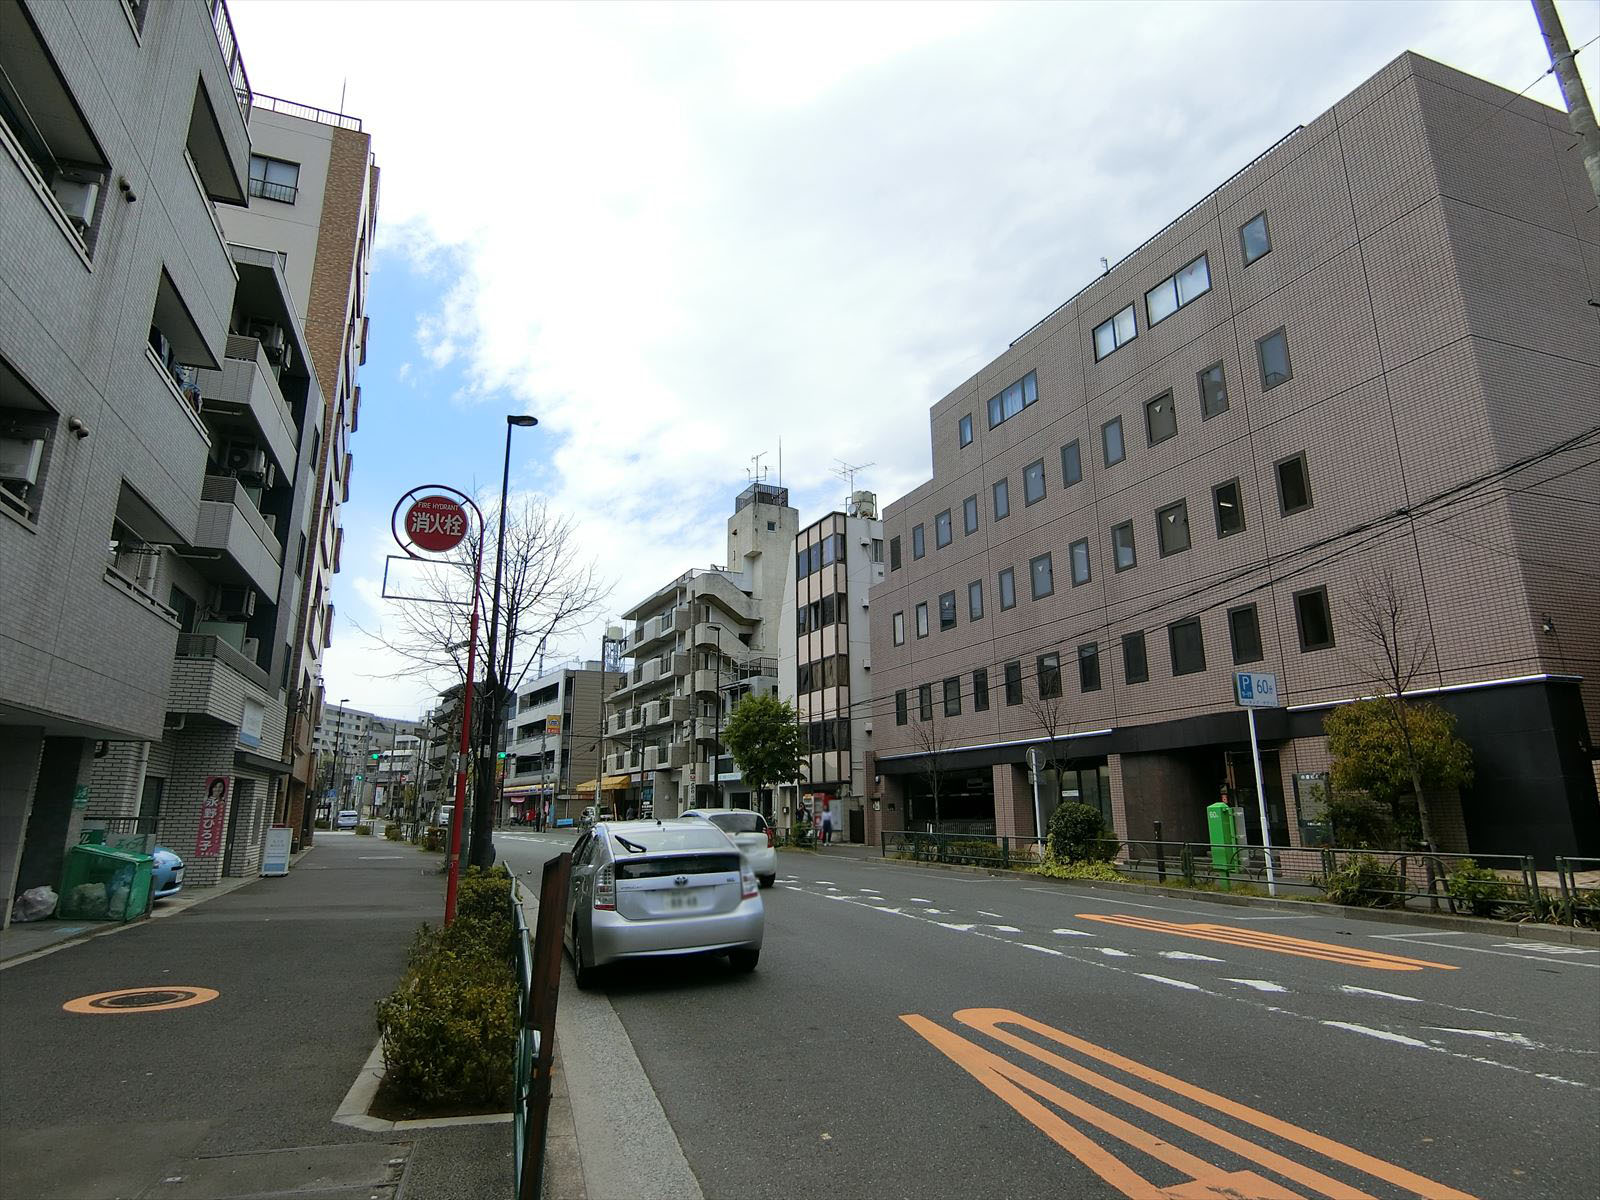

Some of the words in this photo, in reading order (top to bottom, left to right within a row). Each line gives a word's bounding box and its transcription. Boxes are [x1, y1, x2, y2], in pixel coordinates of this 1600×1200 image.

[418, 501, 431, 509] FIRE
[432, 503, 458, 511] HYDRANT
[411, 511, 463, 536] 消火栓
[1242, 676, 1249, 690] P
